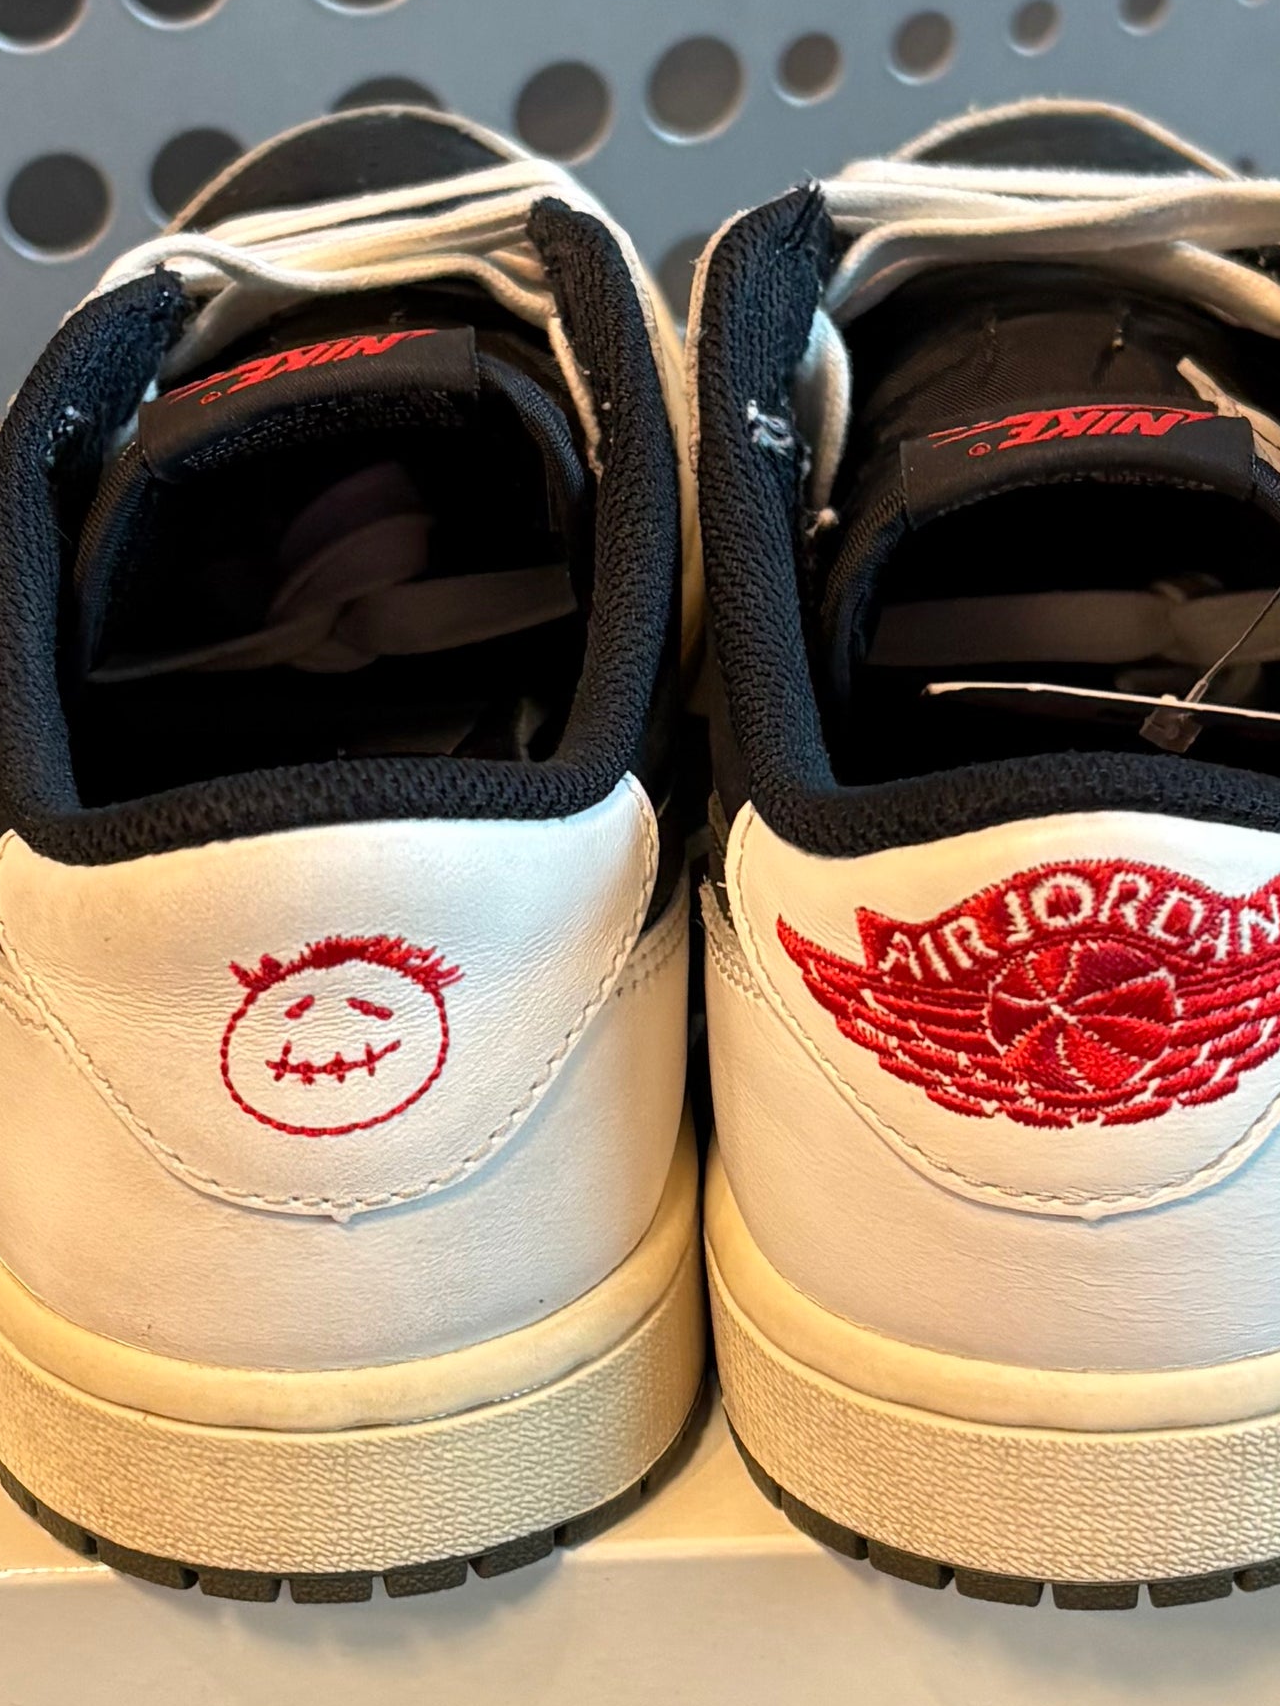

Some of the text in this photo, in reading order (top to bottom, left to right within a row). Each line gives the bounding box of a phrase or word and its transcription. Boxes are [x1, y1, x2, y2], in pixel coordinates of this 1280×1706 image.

[226, 333, 404, 394] NIKE
[997, 407, 1185, 451] NIKE
[877, 915, 998, 984] AIR
